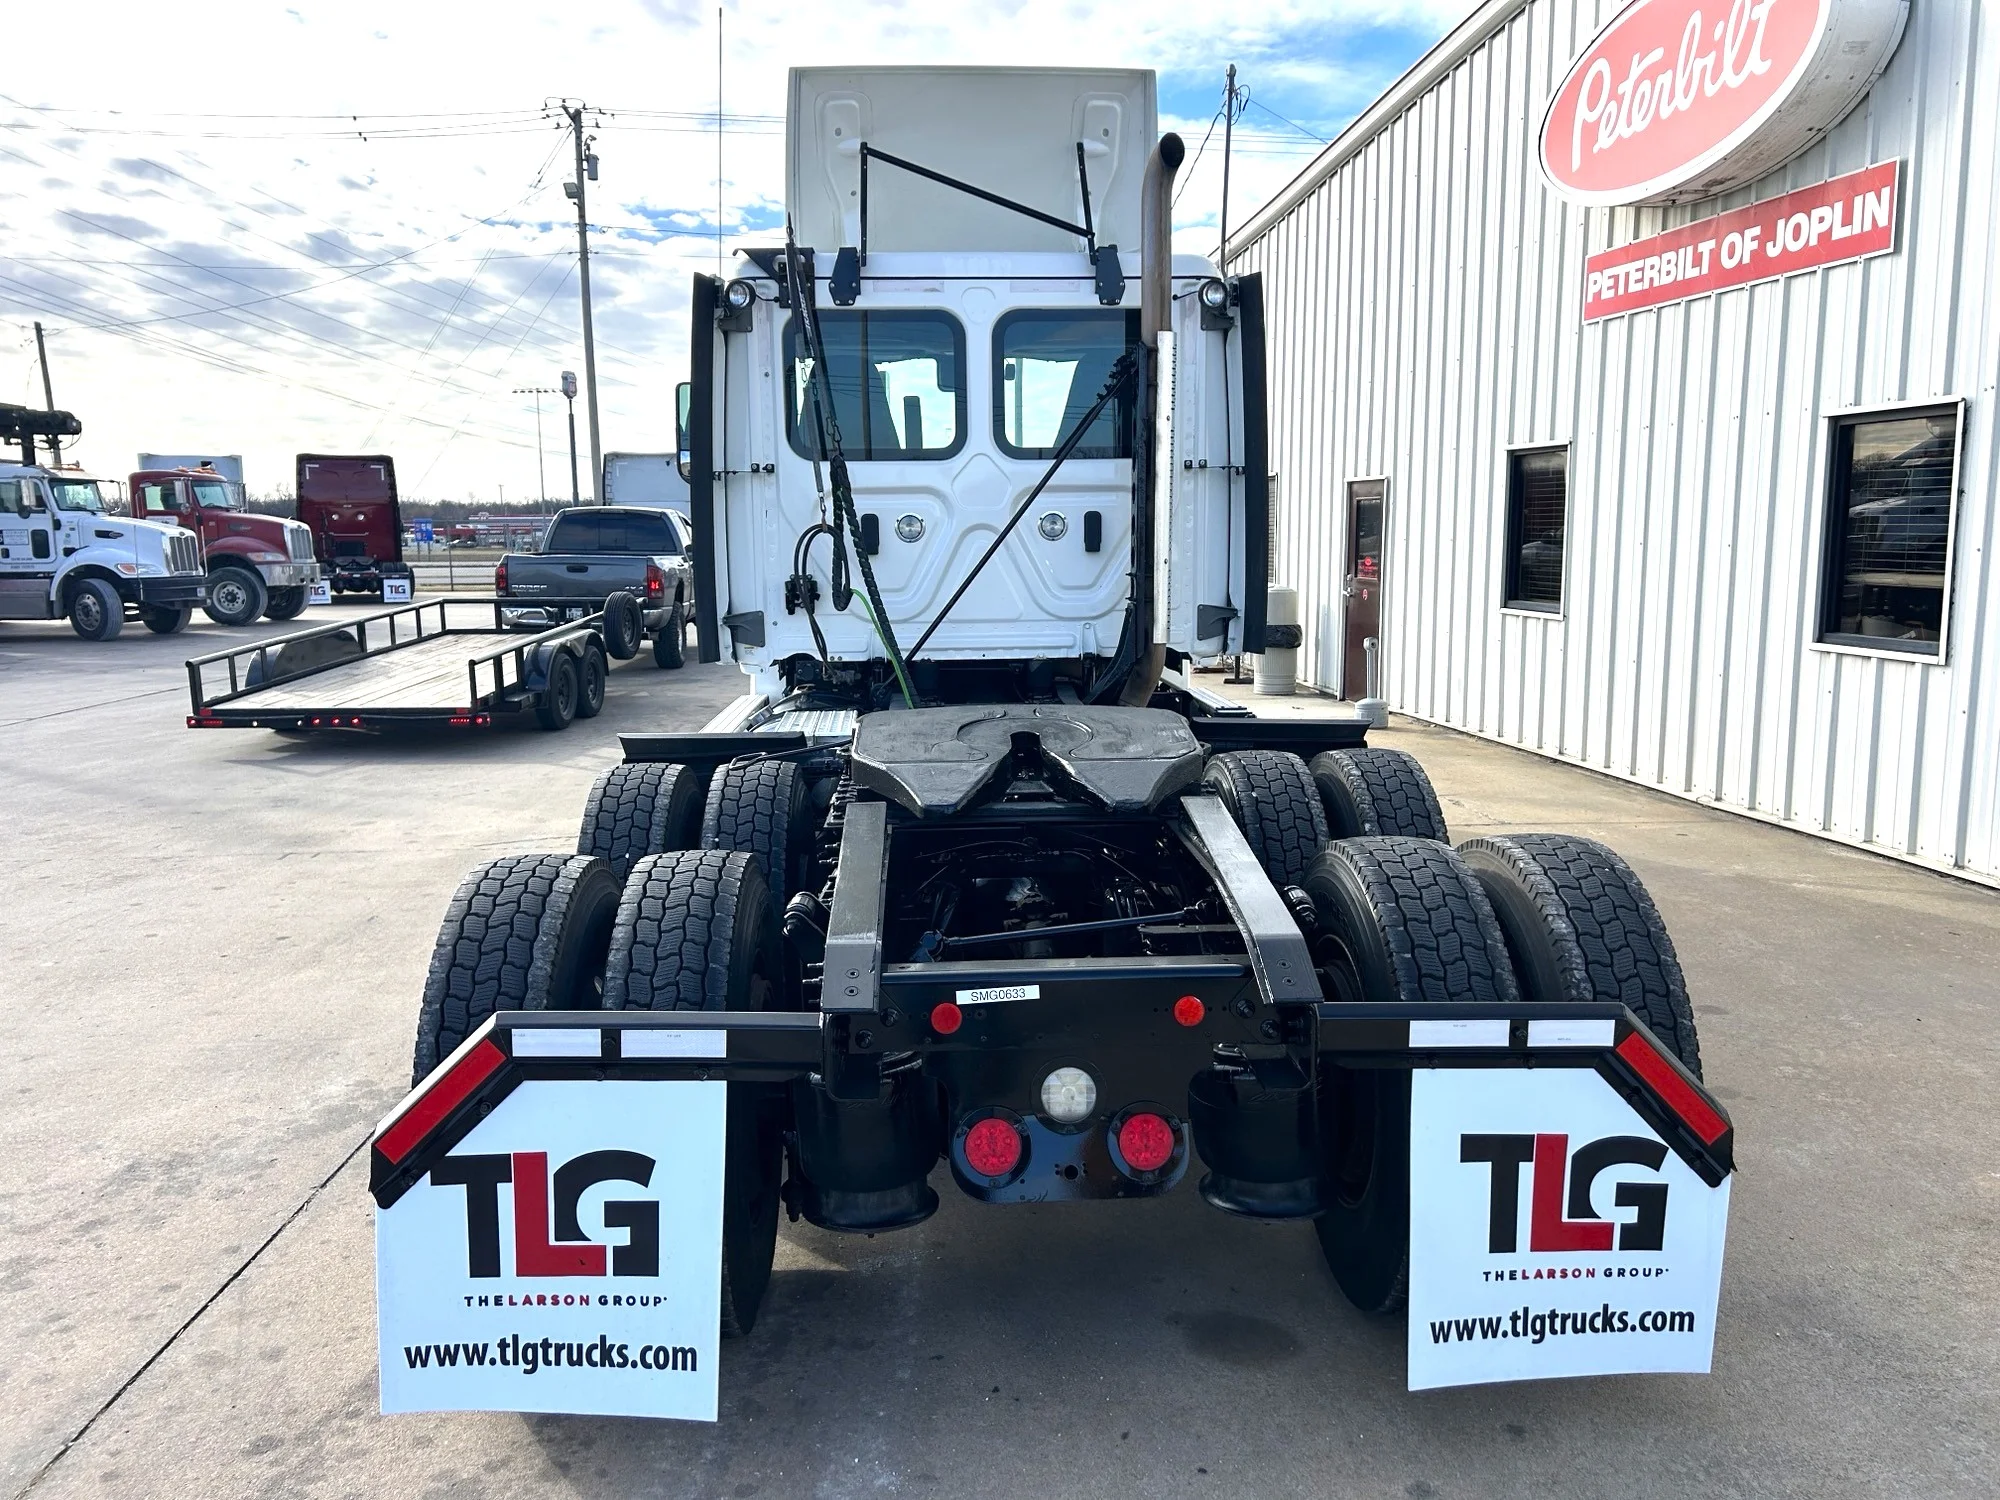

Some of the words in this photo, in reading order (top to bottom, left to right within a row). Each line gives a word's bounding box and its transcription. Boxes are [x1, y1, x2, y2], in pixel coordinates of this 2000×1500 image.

[1572, 0, 1778, 173] Peterbilt
[1586, 239, 1716, 303] PETERBILT
[1720, 225, 1761, 269] OF
[1766, 186, 1890, 258] JOPLIN
[387, 584, 406, 594] TLG
[970, 988, 1026, 1002] SMG0633
[430, 1149, 660, 1278] TLG
[1459, 1133, 1669, 1254] TLG
[1604, 1267, 1669, 1278] GROUP
[598, 1295, 668, 1307] GROUP
[1430, 1303, 1695, 1344] www.tlgtrucks.com
[403, 1334, 698, 1375] www.tlgtrucks.com
